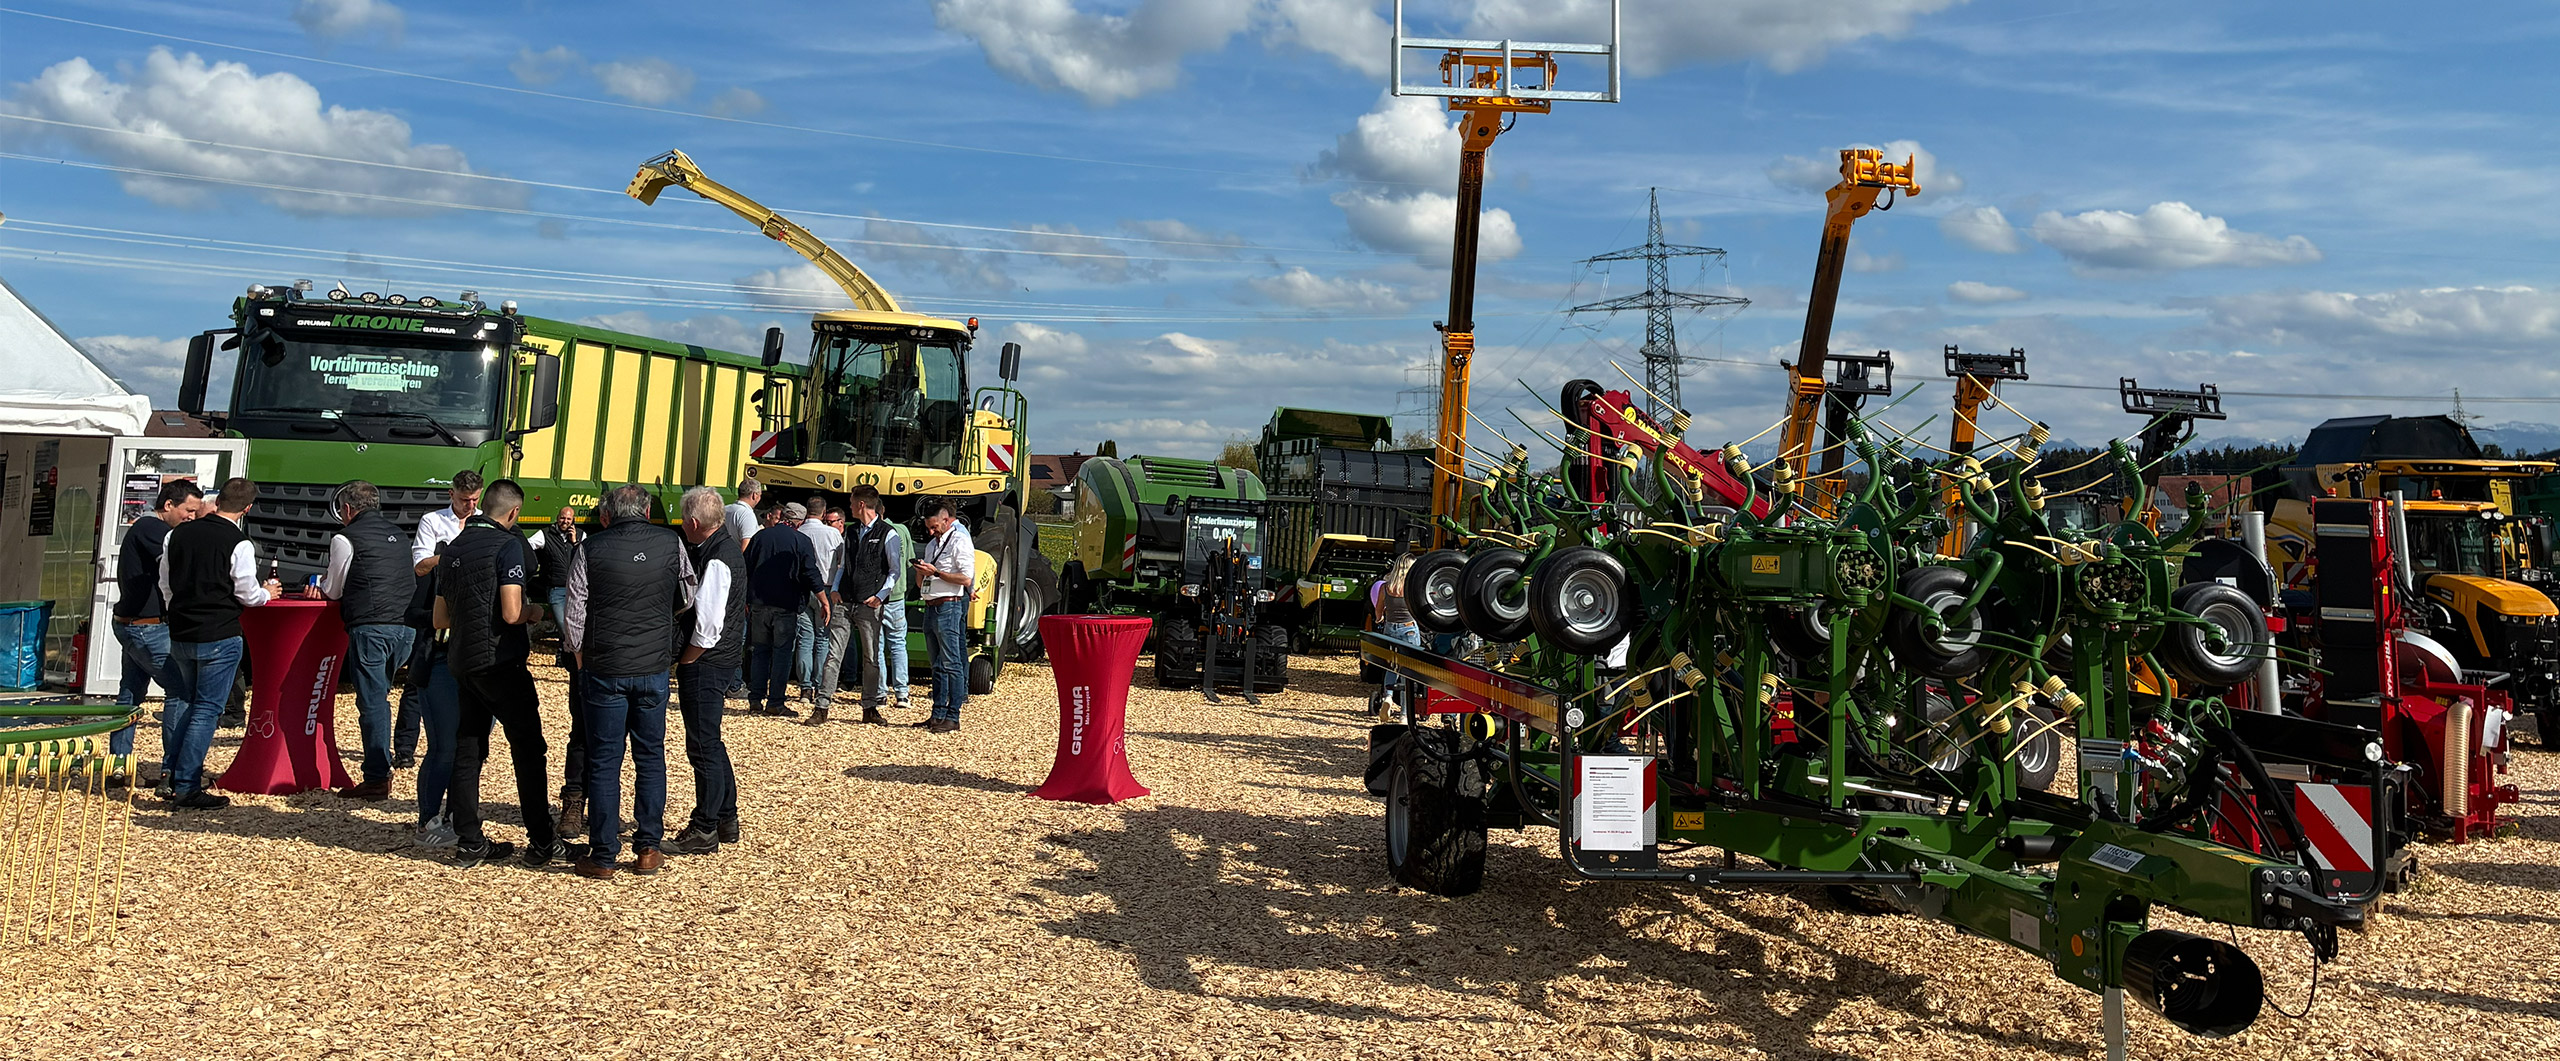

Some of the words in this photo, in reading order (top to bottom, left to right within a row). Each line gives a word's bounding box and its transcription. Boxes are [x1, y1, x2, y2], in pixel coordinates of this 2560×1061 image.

[297, 319, 331, 327] GRUMA
[331, 314, 425, 332] KRONE
[423, 326, 456, 335] GRUMA
[310, 355, 439, 378] Vorführmaschine
[769, 478, 793, 486] GRUMA
[569, 494, 584, 506] GX
[1194, 515, 1257, 529] Sonderfinanzierung
[1212, 527, 1237, 542] 0,0%
[305, 656, 332, 735] GRUMA
[1071, 686, 1083, 756] GRUMA
